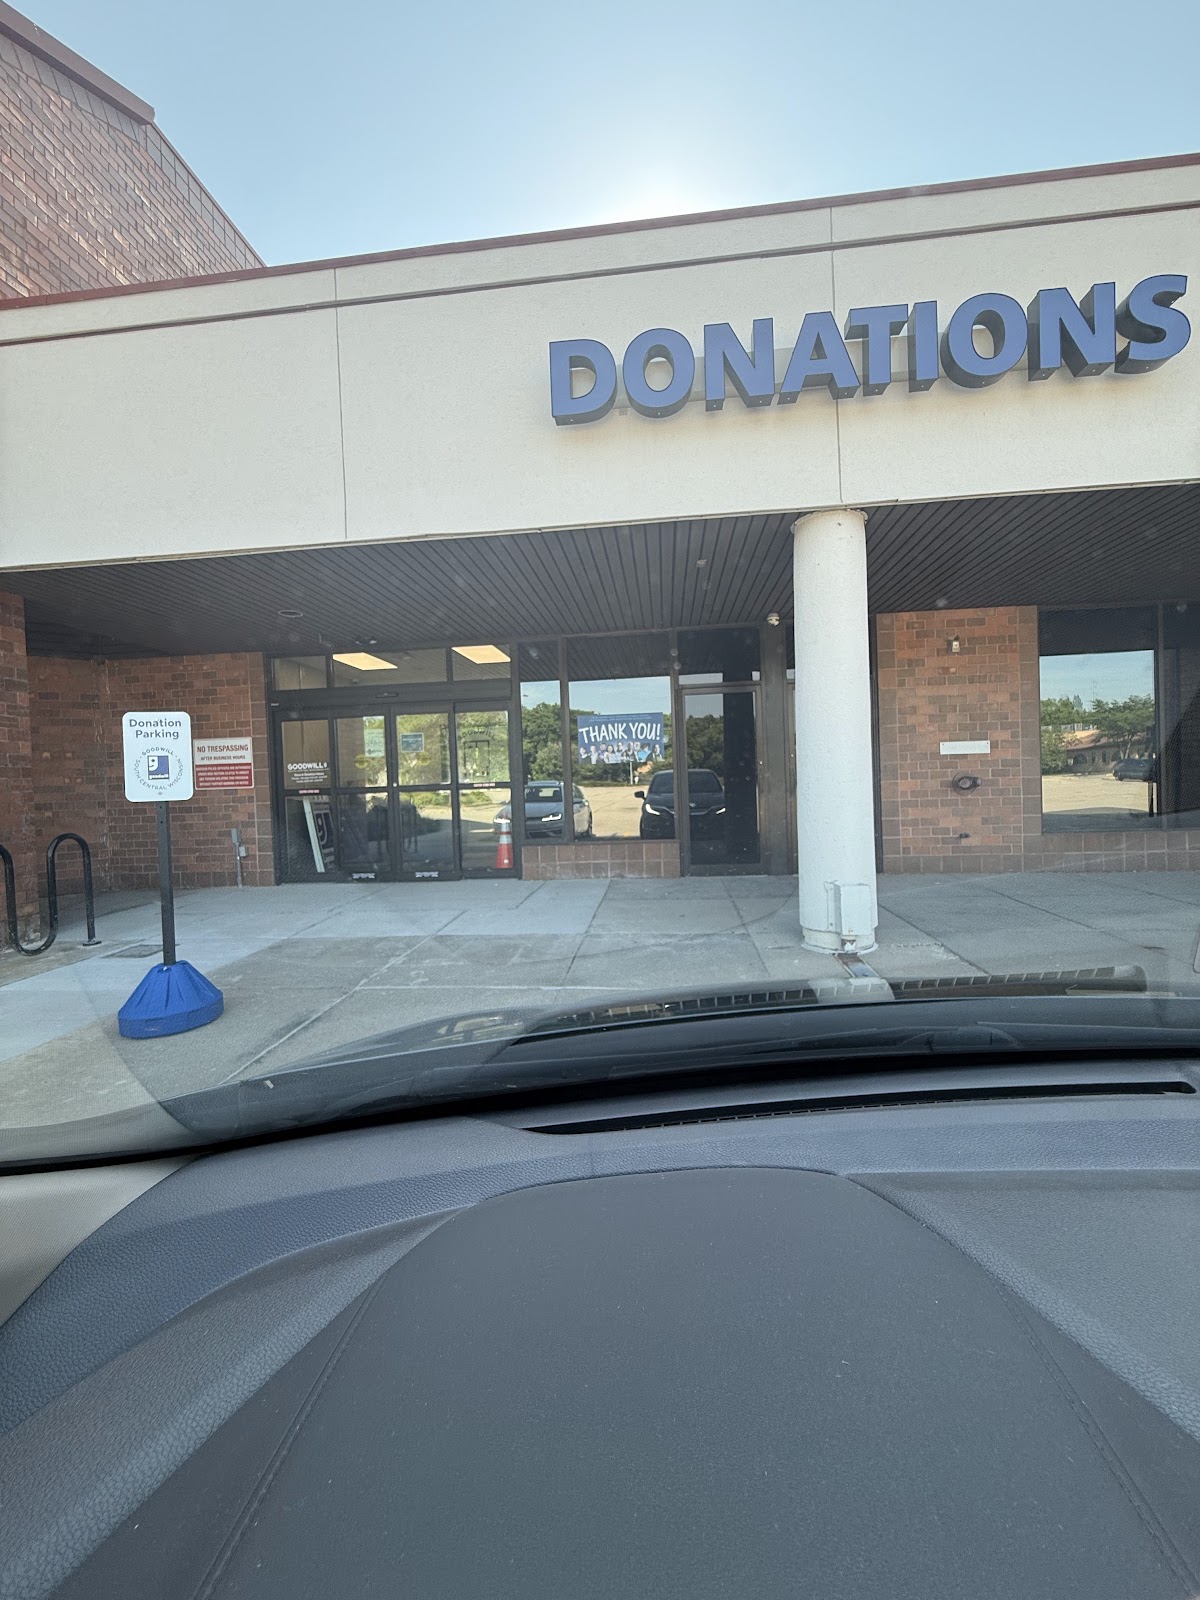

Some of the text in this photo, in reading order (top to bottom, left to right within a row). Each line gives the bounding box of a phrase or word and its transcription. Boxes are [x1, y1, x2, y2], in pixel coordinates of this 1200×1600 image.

[549, 274, 1191, 424] DONATIONS
[129, 719, 182, 728] Donation
[135, 729, 180, 740] Parking
[578, 722, 661, 744] THANK YOU!
[141, 746, 174, 756] GOODWILL
[207, 744, 249, 753] TRESPASSING
[287, 762, 324, 771] GOODWILL
[139, 778, 167, 790] CENTRAL
